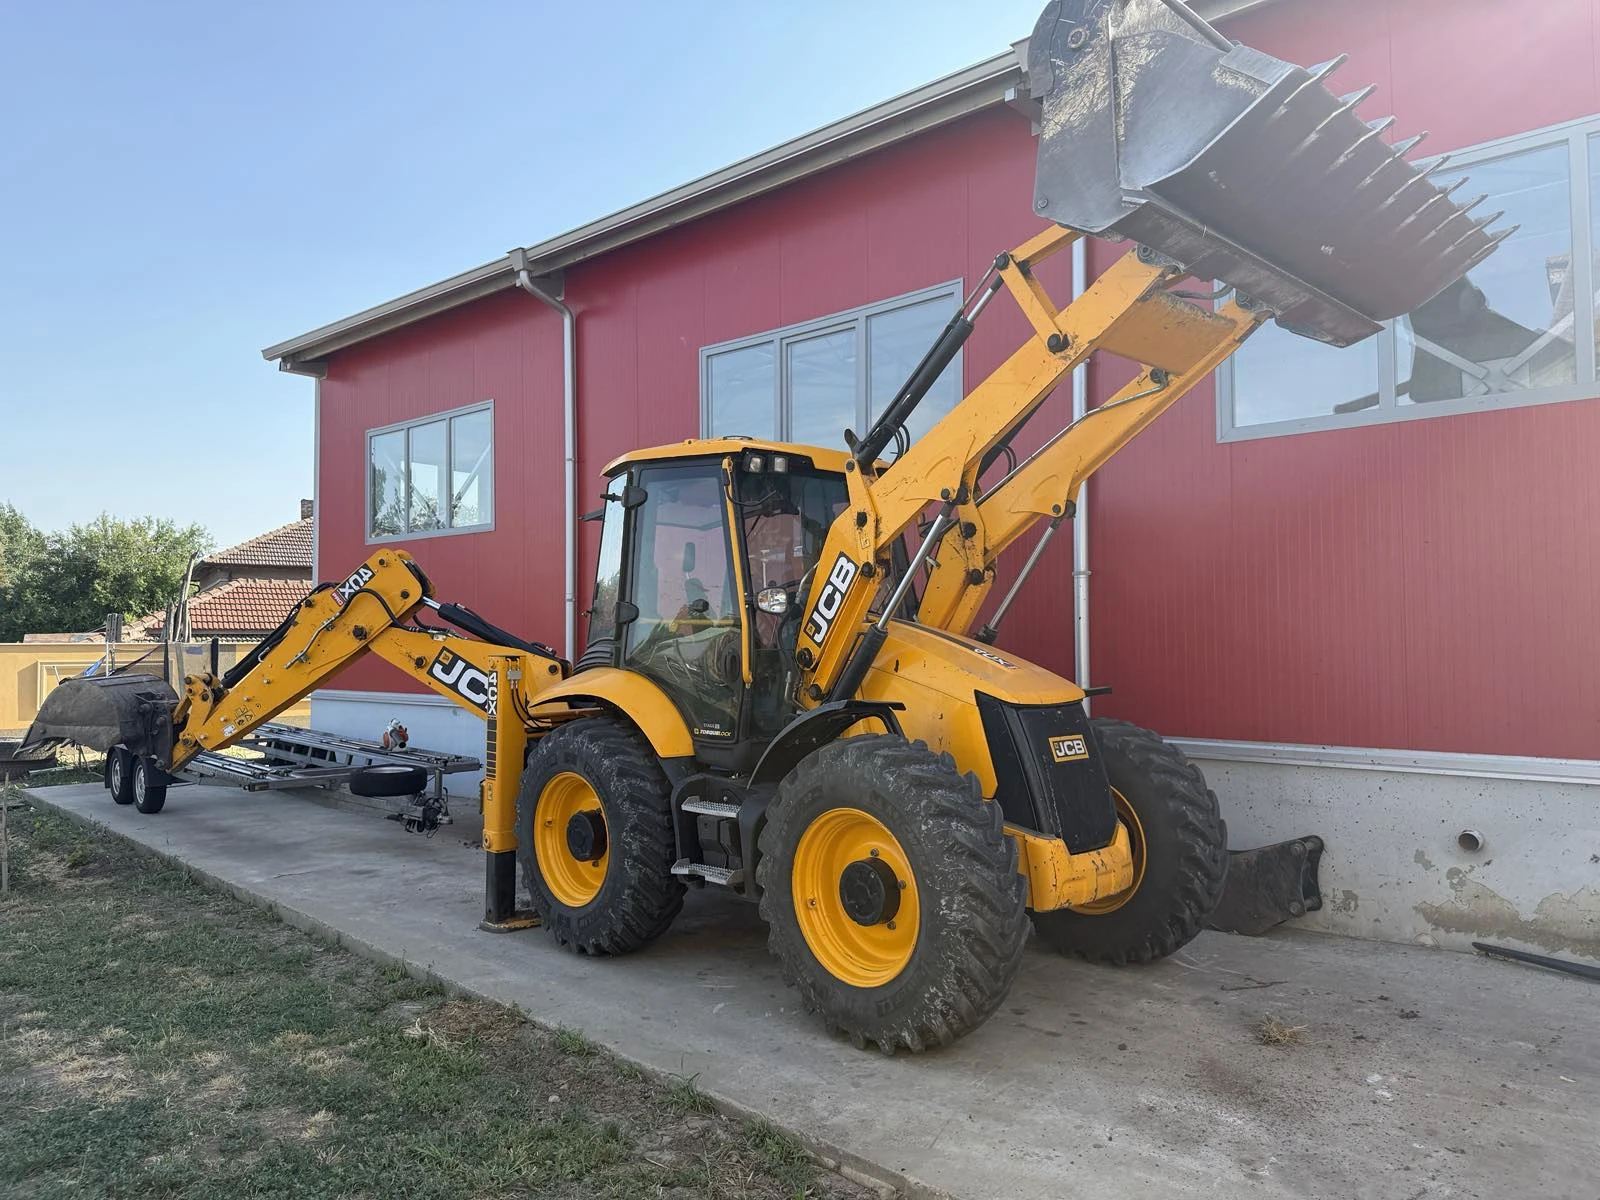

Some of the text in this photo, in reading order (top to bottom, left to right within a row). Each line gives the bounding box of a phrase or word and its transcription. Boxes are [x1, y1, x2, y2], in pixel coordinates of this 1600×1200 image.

[332, 592, 344, 605] PRO
[339, 567, 373, 600] 4CX
[812, 556, 856, 643] JCB
[432, 659, 488, 709] JC
[488, 672, 497, 715] 4CX
[1056, 740, 1085, 756] JCB
